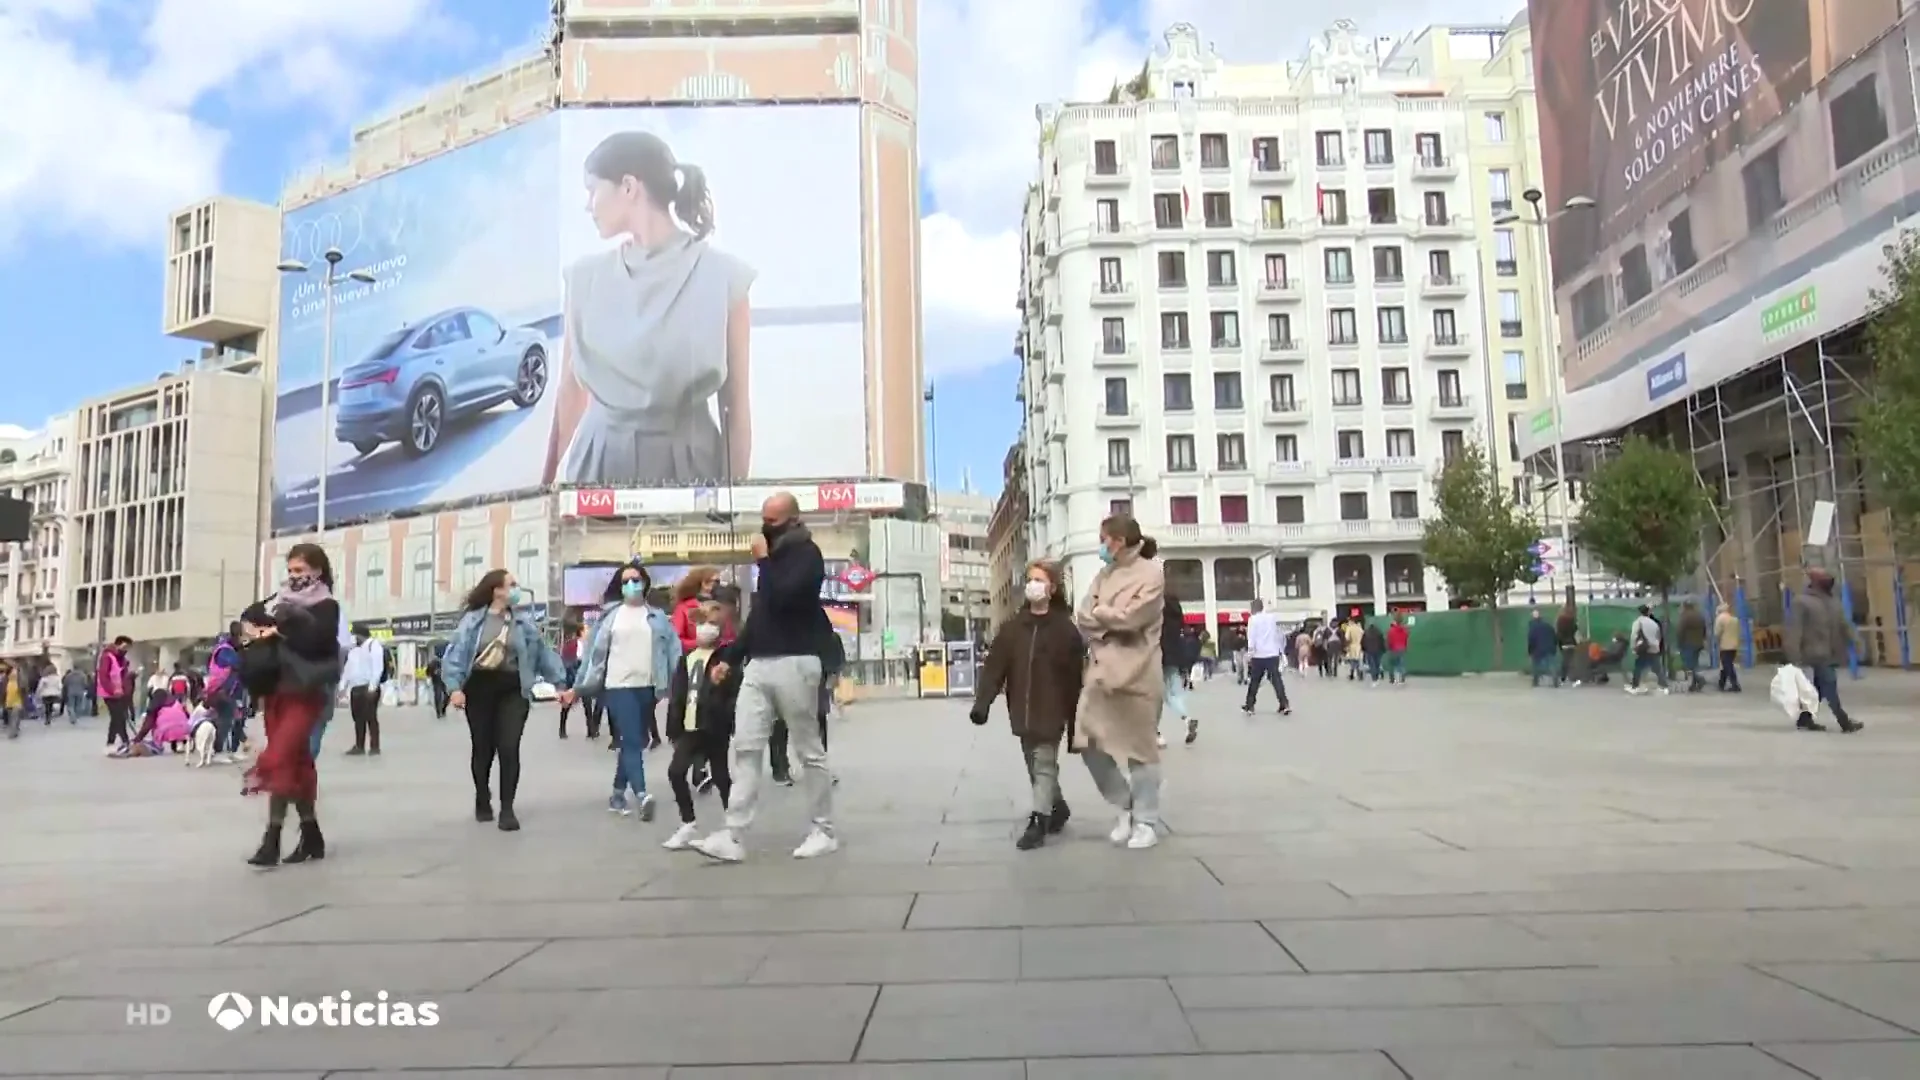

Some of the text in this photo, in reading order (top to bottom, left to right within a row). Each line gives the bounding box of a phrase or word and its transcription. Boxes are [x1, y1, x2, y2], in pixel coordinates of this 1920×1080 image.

[1589, 28, 1607, 58] EL
[1635, 41, 1739, 150] 6 NOVIEMBRE
[1624, 53, 1762, 190] SOLO EN CINES
[580, 491, 612, 507] VSA
[819, 487, 853, 501] VSA
